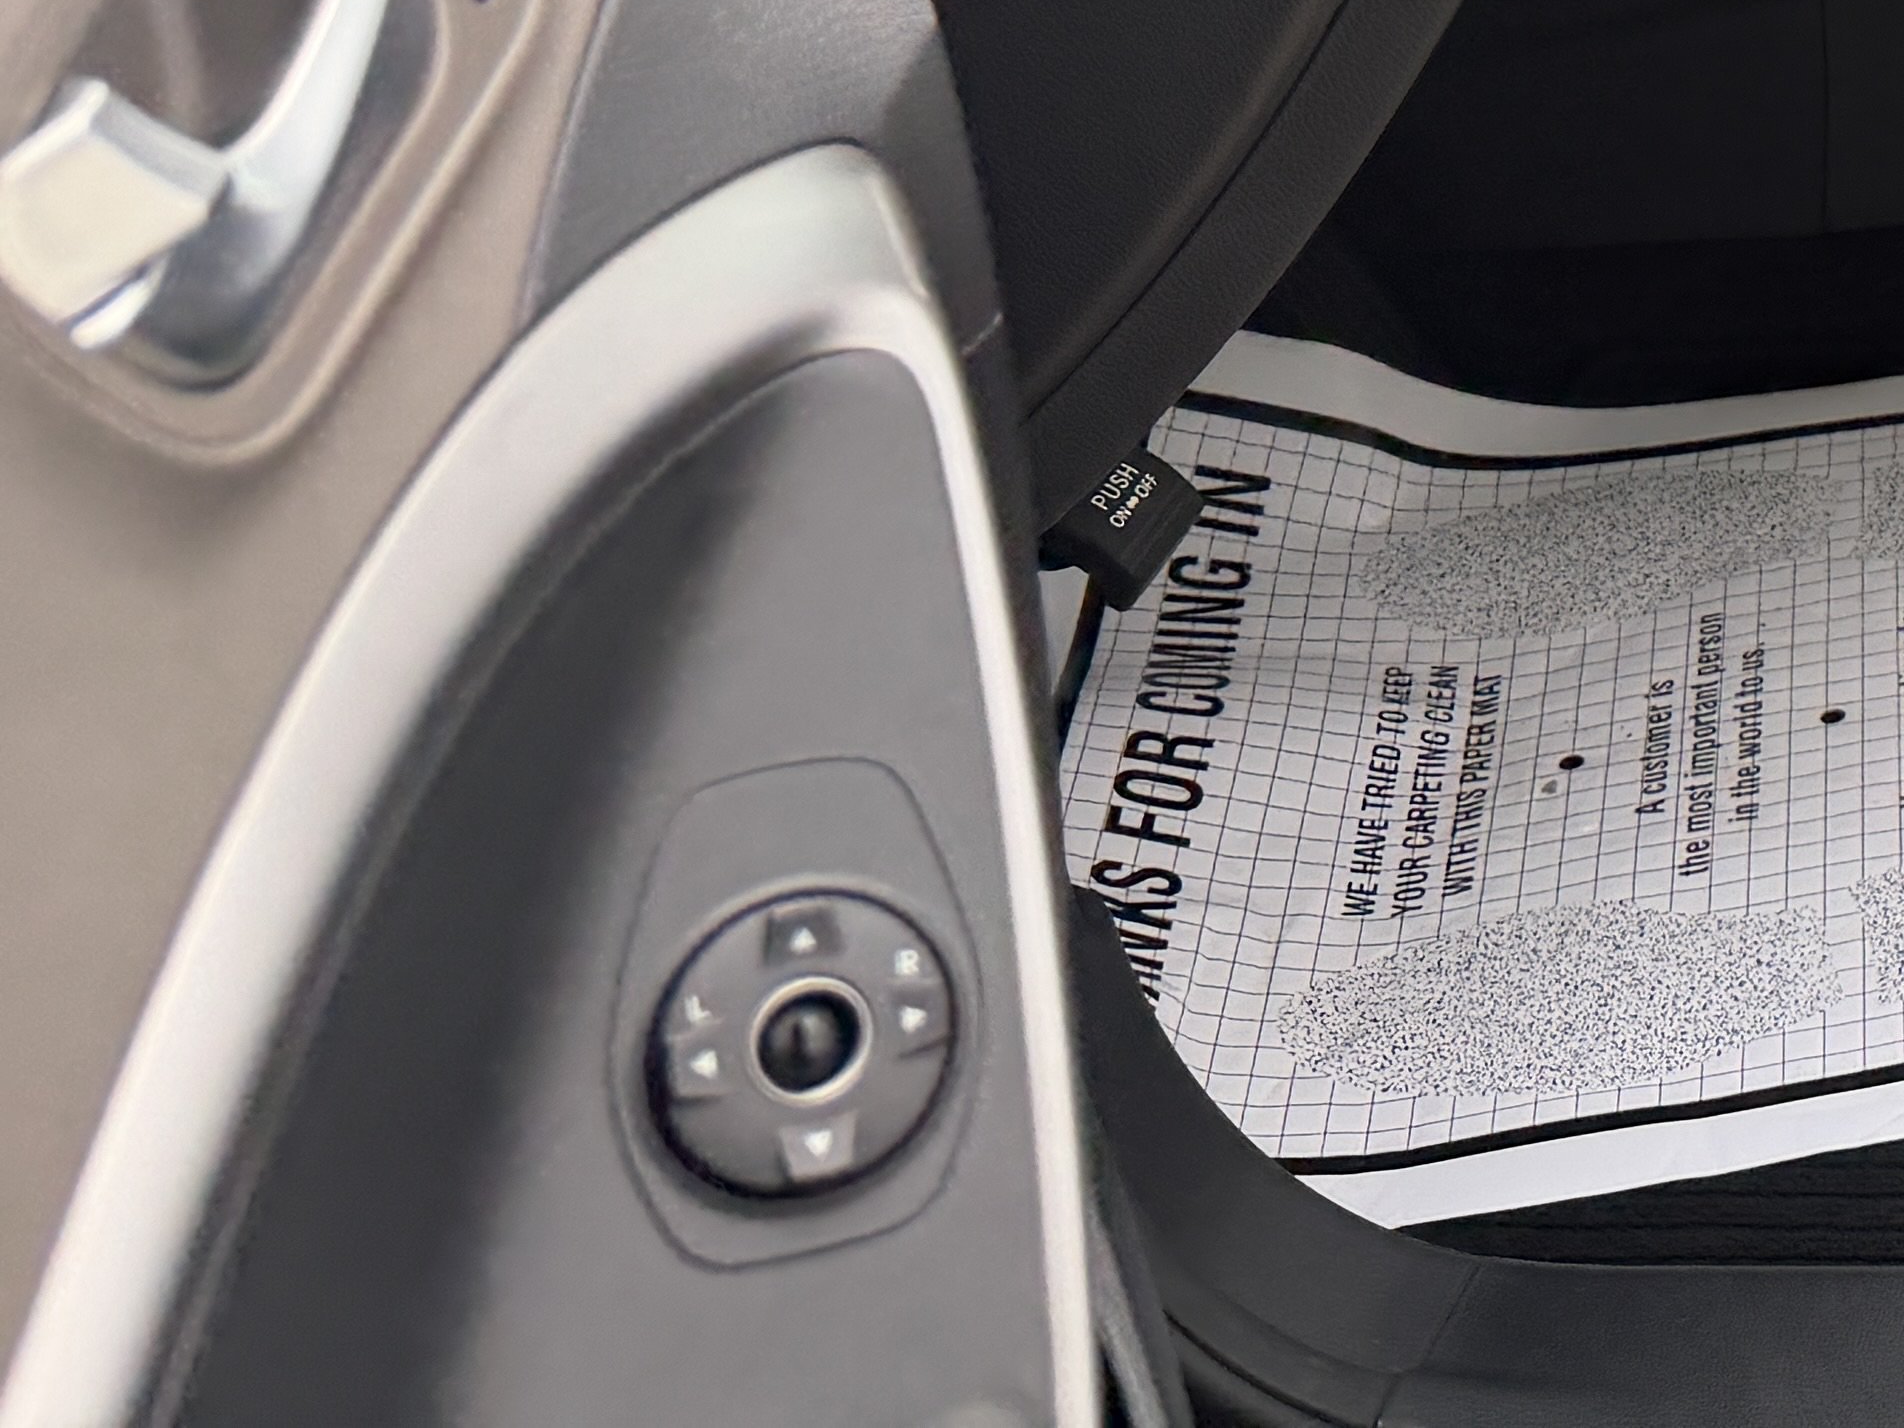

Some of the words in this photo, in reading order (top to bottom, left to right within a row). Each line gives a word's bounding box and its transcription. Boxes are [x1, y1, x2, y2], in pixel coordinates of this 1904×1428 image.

[1091, 463, 1139, 510] PUSH
[1110, 506, 1132, 528] ON
[1135, 474, 1158, 498] OFF
[1194, 464, 1271, 537] IN
[1136, 556, 1252, 718] COMING
[1698, 612, 1725, 676] person
[1383, 666, 1413, 705] KEEP
[1425, 665, 1459, 722] CLEAN
[1471, 674, 1502, 716] MAT
[1645, 679, 1674, 698] is
[1735, 675, 1763, 696] to
[1376, 710, 1408, 735] TO
[1640, 704, 1672, 794] customer
[1684, 679, 1721, 778] important
[1733, 701, 1762, 760] world
[1362, 744, 1401, 810] TRIED
[1460, 720, 1496, 784] PAPER
[1104, 729, 1215, 848] FOR
[1402, 729, 1450, 849] CARPETING
[1635, 799, 1665, 814] A
[1684, 781, 1713, 833] most
[1731, 765, 1761, 797] the
[1451, 787, 1487, 840] THIS
[1728, 803, 1759, 822] in
[1351, 819, 1389, 875] HAVE
[1442, 838, 1479, 897] WITH
[1679, 839, 1710, 876] the
[1341, 882, 1378, 916] WE
[1392, 855, 1431, 917] YOUR
[894, 948, 920, 975] R
[683, 994, 711, 1022] L
